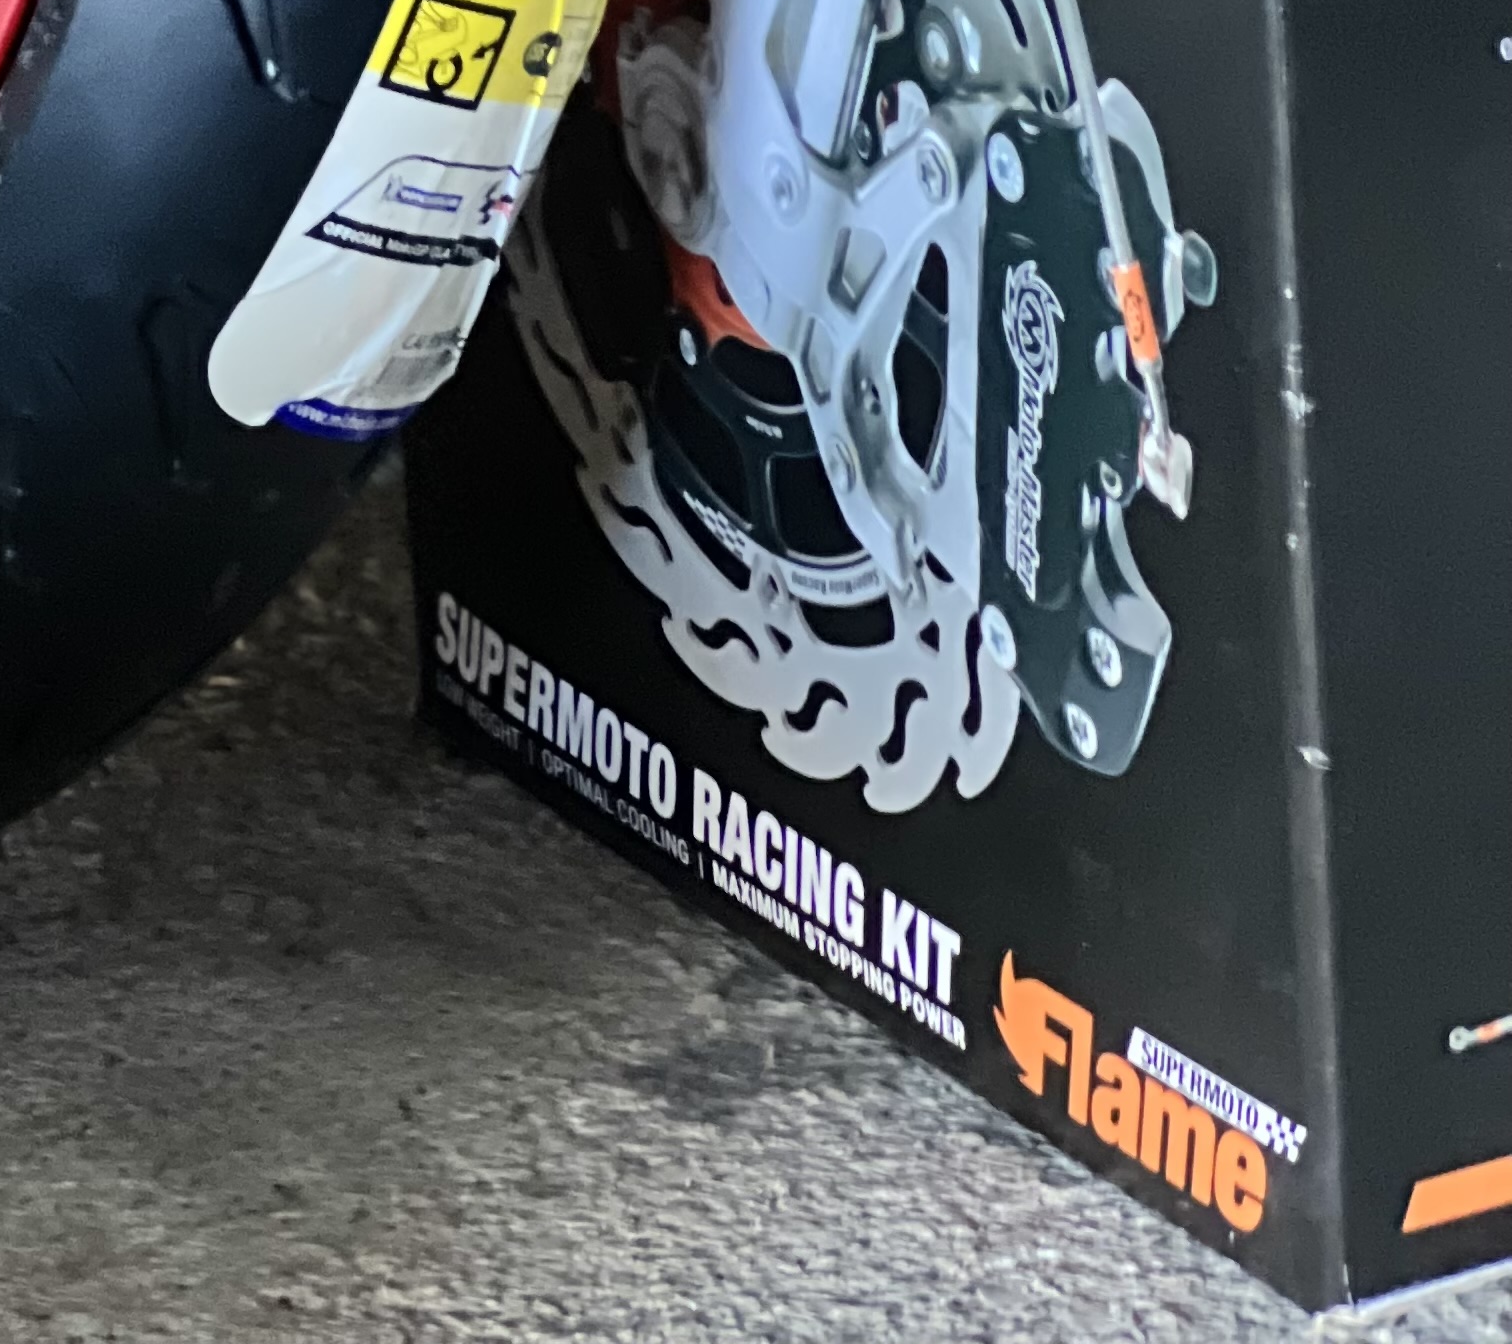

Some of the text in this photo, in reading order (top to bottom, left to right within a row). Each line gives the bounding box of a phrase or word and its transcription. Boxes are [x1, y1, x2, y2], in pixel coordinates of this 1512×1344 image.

[437, 591, 962, 1006] SUPERMOTO RACING KIT
[541, 748, 615, 816] OPTIMAL
[615, 797, 691, 865] COOLING
[712, 858, 800, 941] MAXIMUM
[803, 920, 896, 1004] STOPPING
[899, 983, 967, 1051] POWER
[993, 948, 1267, 1233] Flame
[1140, 1032, 1259, 1130] SUPERMOTO
